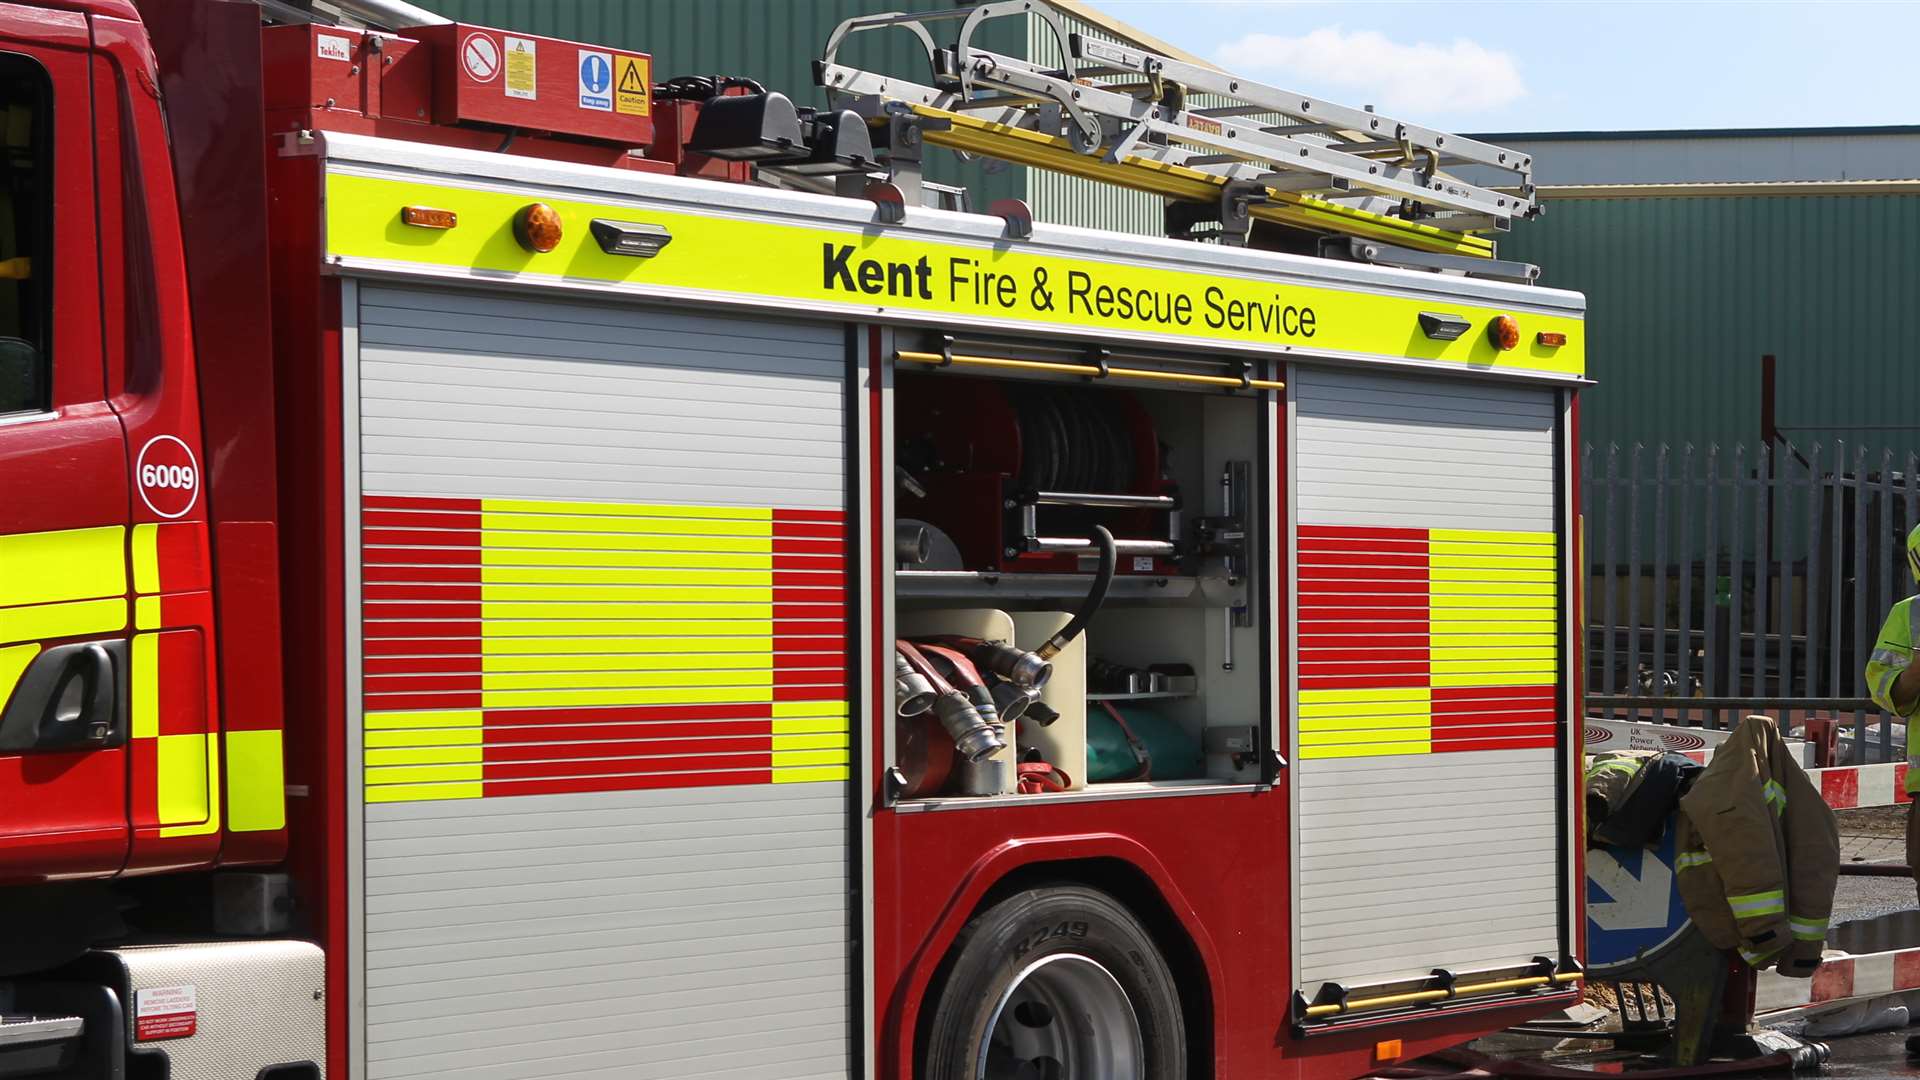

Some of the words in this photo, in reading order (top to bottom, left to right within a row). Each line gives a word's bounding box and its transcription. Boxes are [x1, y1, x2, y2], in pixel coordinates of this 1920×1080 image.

[620, 95, 646, 105] Caution
[824, 243, 933, 300] Kent
[950, 258, 1017, 308] Fire
[1030, 267, 1055, 311] &
[1069, 271, 1192, 325] Rescue
[1204, 287, 1316, 338] Service
[142, 464, 195, 490] 6009
[1630, 727, 1641, 735] UK
[1630, 736, 1654, 744] Power
